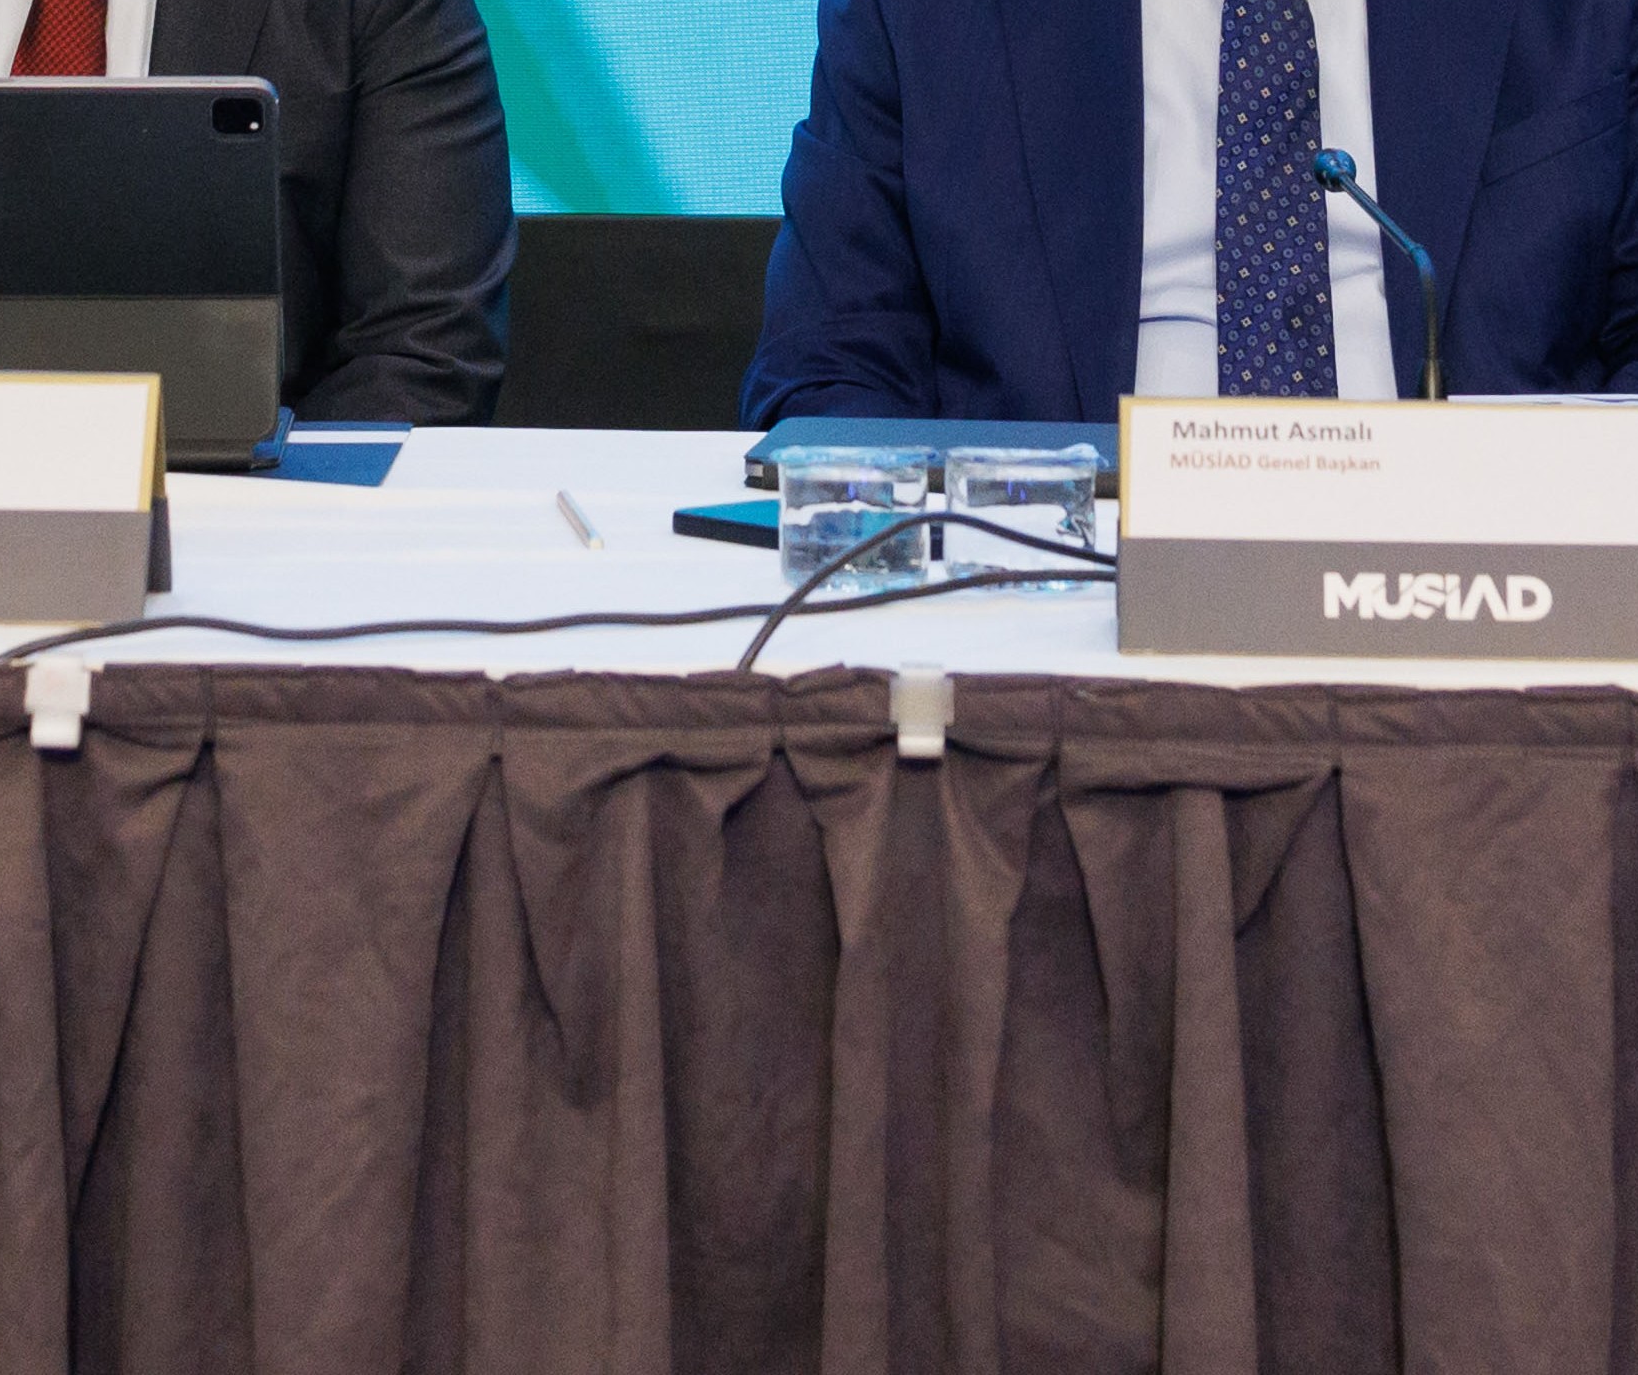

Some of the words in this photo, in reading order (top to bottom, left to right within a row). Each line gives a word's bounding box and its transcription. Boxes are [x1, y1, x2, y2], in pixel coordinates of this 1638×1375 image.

[1173, 421, 1279, 441] Mahmut
[1288, 421, 1372, 442] Asmalı
[1257, 454, 1310, 471] Genel
[1315, 456, 1380, 476] Başkan
